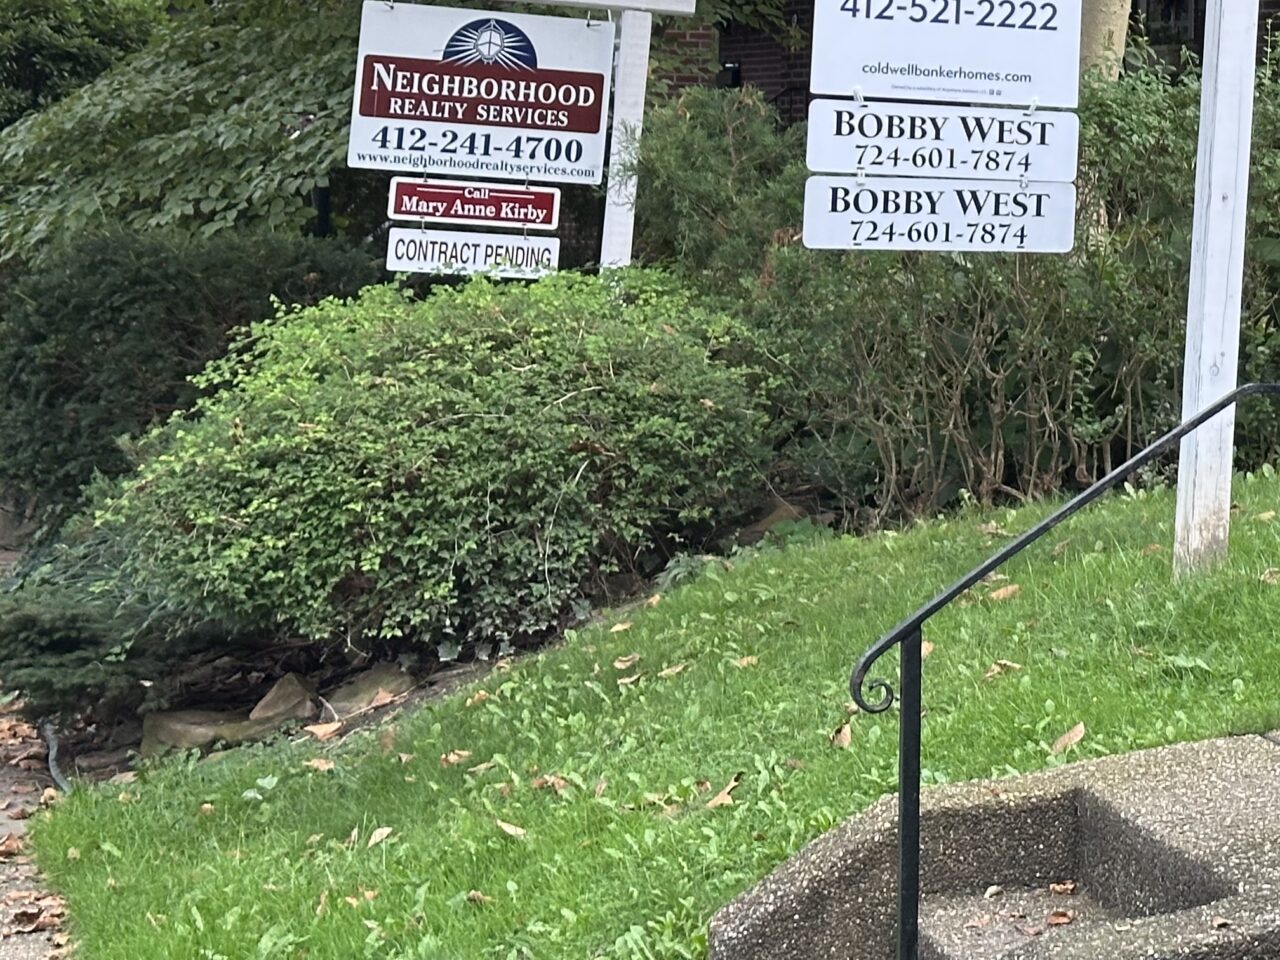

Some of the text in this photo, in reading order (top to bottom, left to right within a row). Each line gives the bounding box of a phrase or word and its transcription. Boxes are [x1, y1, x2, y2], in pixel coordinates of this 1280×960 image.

[371, 62, 595, 107] NEIGHBORHOOD
[862, 62, 1032, 84] coldwellbankerhomes.com
[389, 97, 569, 127] REALTY SERVICES
[833, 109, 1054, 146] BOBBY WEST
[371, 126, 583, 163] 412-241-4700
[855, 144, 1032, 173] 724-601-7874
[357, 151, 595, 178] www.neighborhoodrealtyservices.com
[463, 187, 489, 199] Call
[829, 186, 1050, 218] BOBBY WEST
[400, 195, 547, 223] Mary Anne Kirby
[850, 220, 1028, 246] 724-601-7874
[394, 238, 551, 269] CONTRACT PENDING
